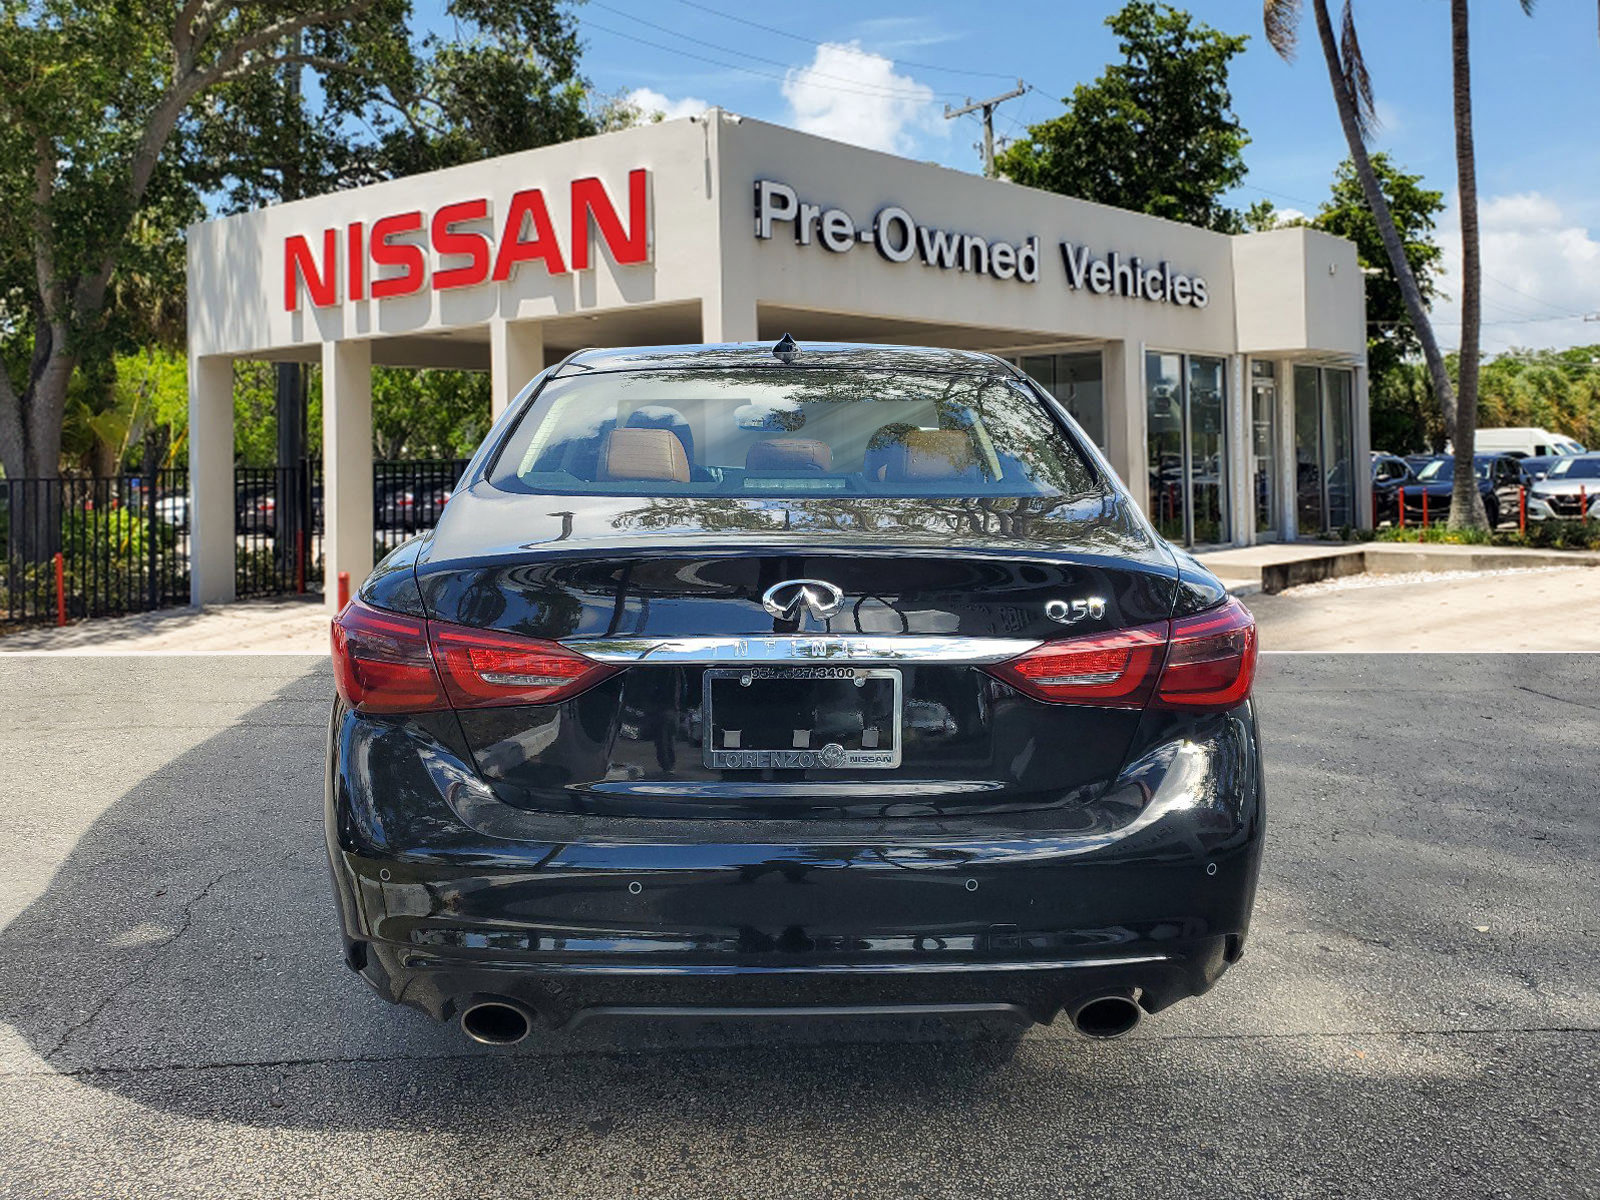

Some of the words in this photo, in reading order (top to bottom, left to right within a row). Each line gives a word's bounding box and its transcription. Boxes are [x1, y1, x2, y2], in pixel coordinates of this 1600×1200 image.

[285, 169, 648, 311] NISSAN
[755, 180, 1040, 283] Pre-Owned
[1060, 241, 1208, 308] Vehicles
[1045, 597, 1106, 626] Q50
[713, 752, 815, 768] LORENZO
